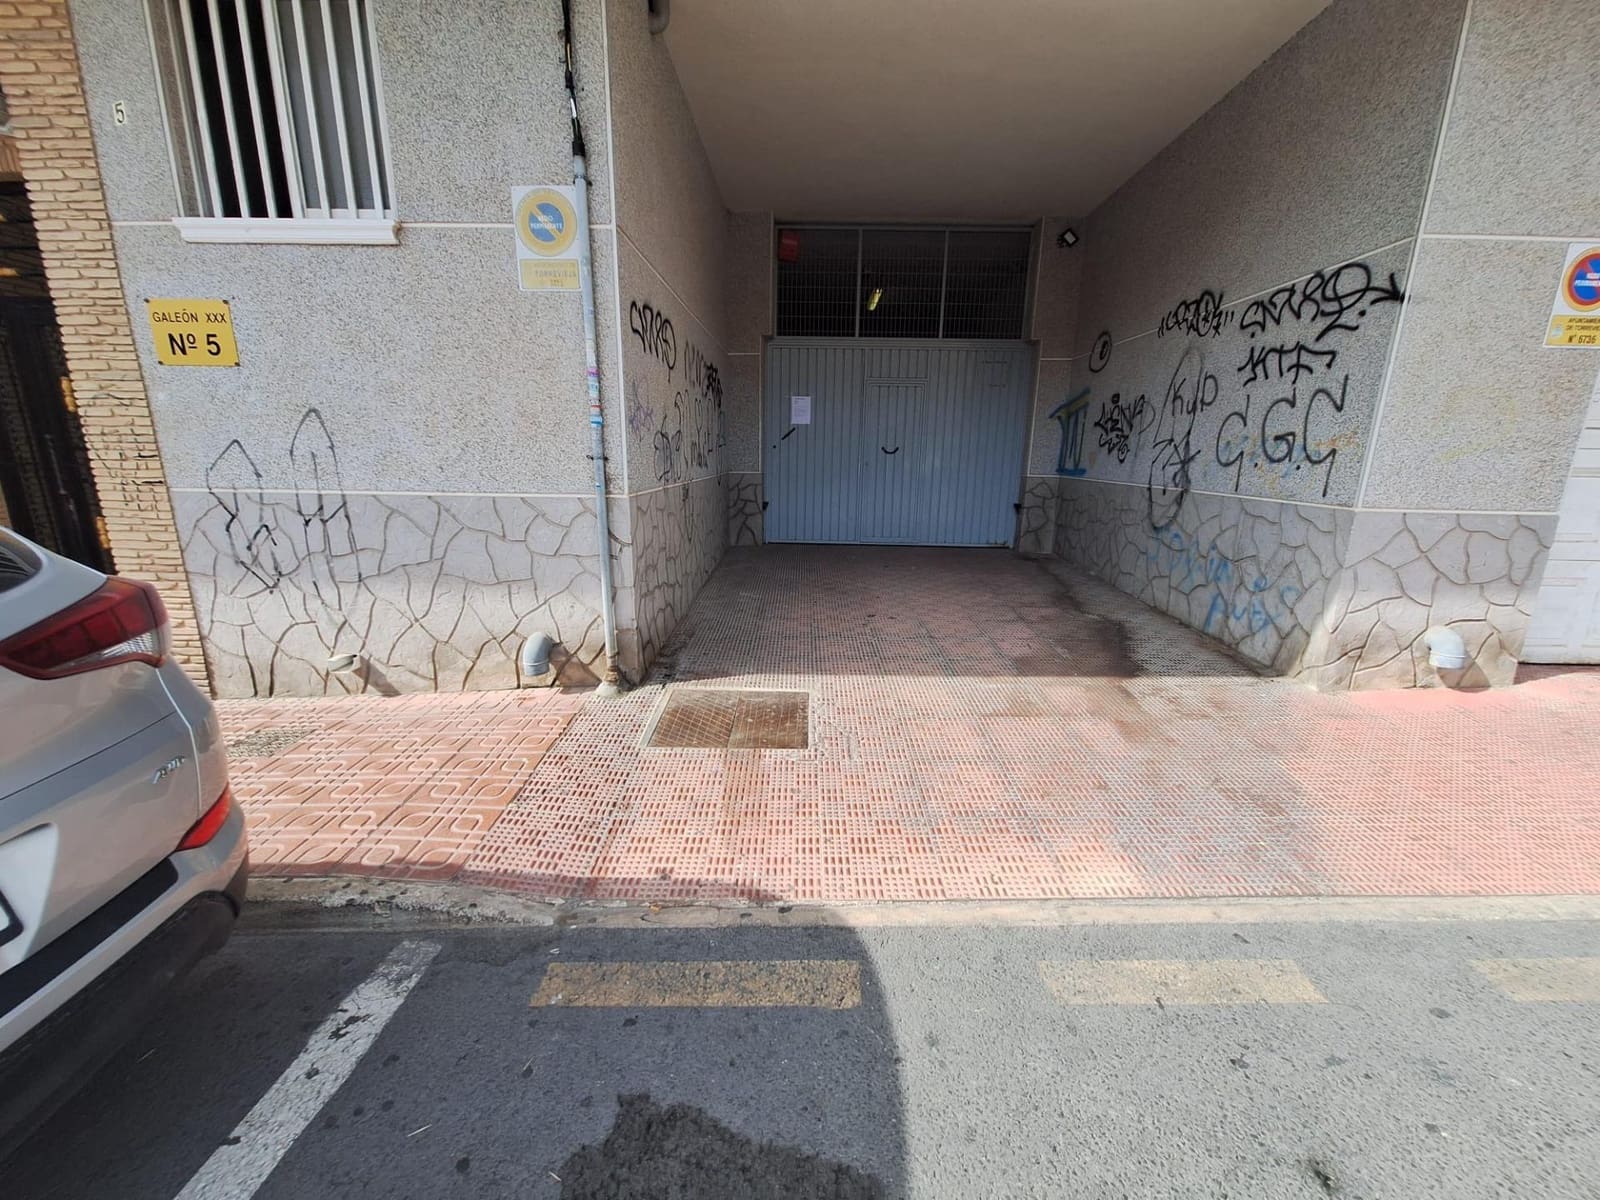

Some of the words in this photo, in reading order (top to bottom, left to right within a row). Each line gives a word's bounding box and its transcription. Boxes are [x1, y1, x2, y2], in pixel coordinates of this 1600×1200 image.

[114, 102, 125, 124] 5
[152, 308, 199, 323] GALEÓN
[205, 312, 227, 323] XXX
[168, 333, 198, 356] Nº
[206, 333, 222, 356] 5
